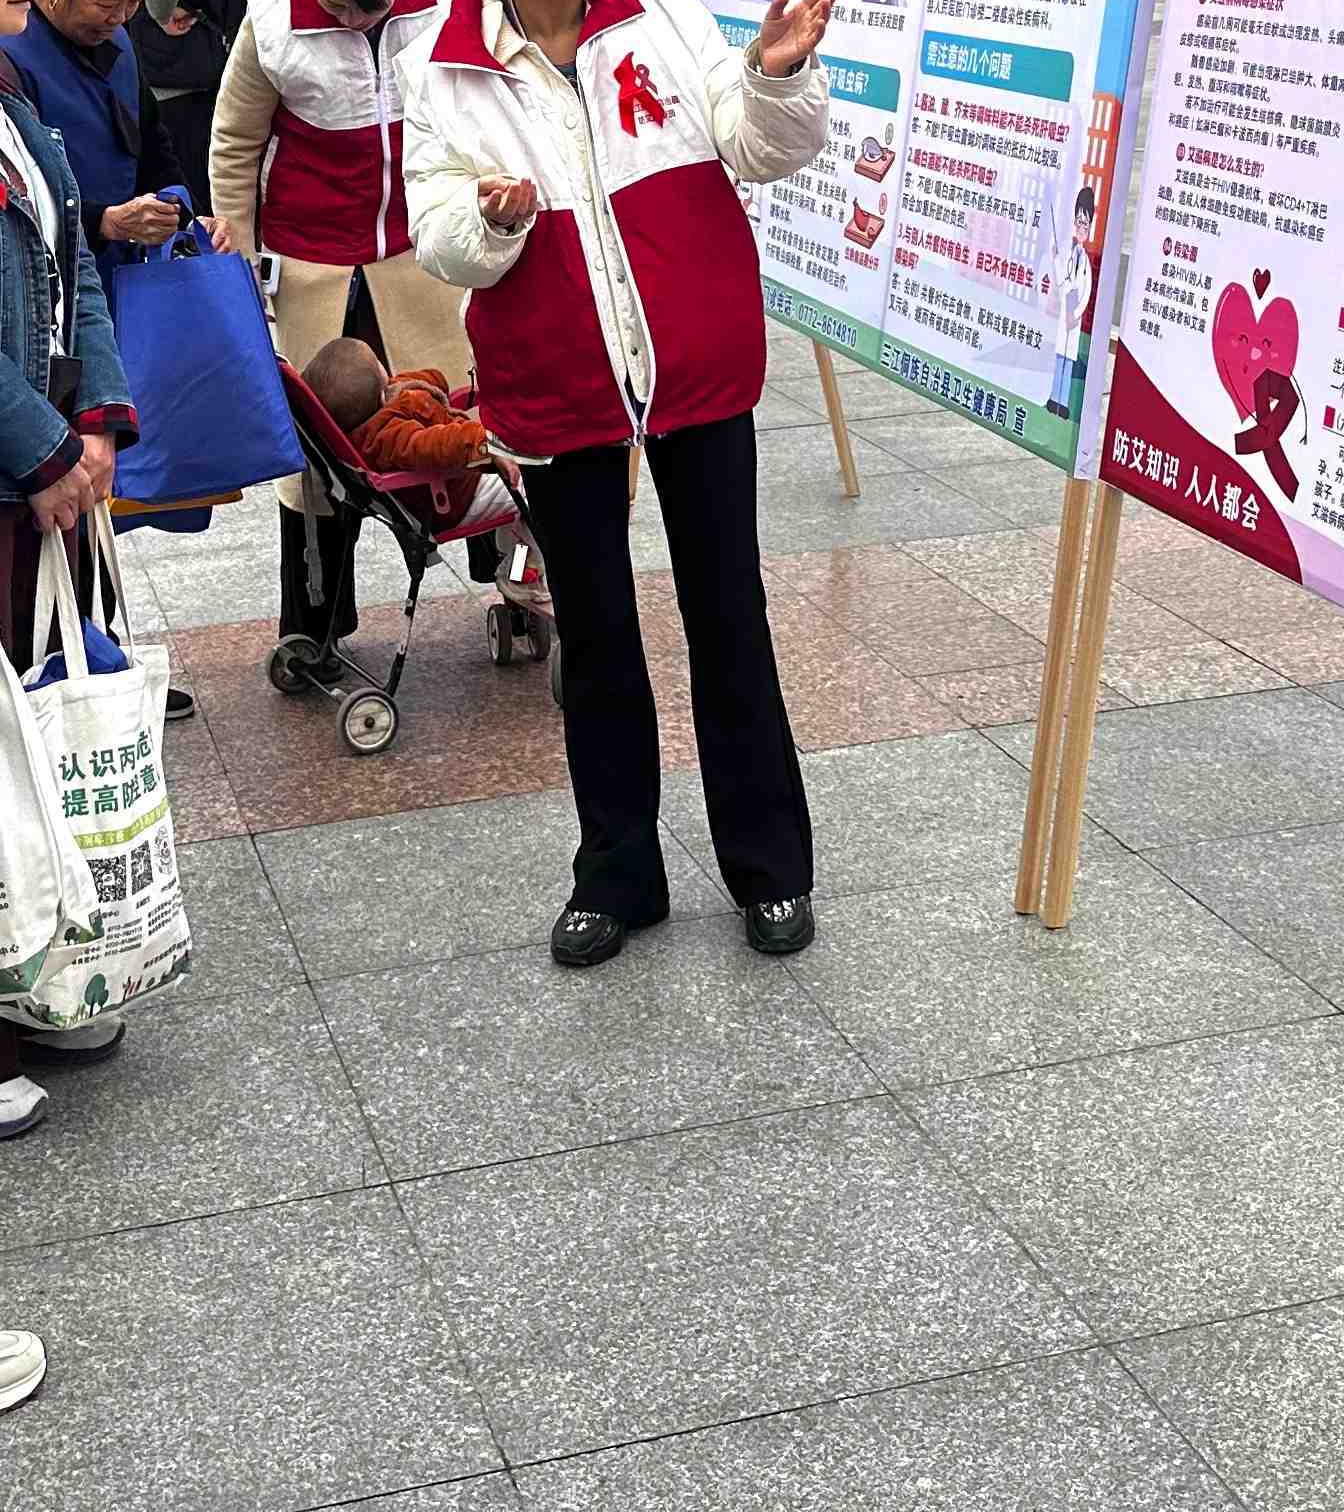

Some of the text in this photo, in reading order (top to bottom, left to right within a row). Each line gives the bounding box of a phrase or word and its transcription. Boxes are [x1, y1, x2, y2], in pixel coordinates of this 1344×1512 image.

[880, 342, 1008, 428] 三江侗族自治县卫生健康局
[1112, 428, 1260, 531] 防艾知识 人人都会
